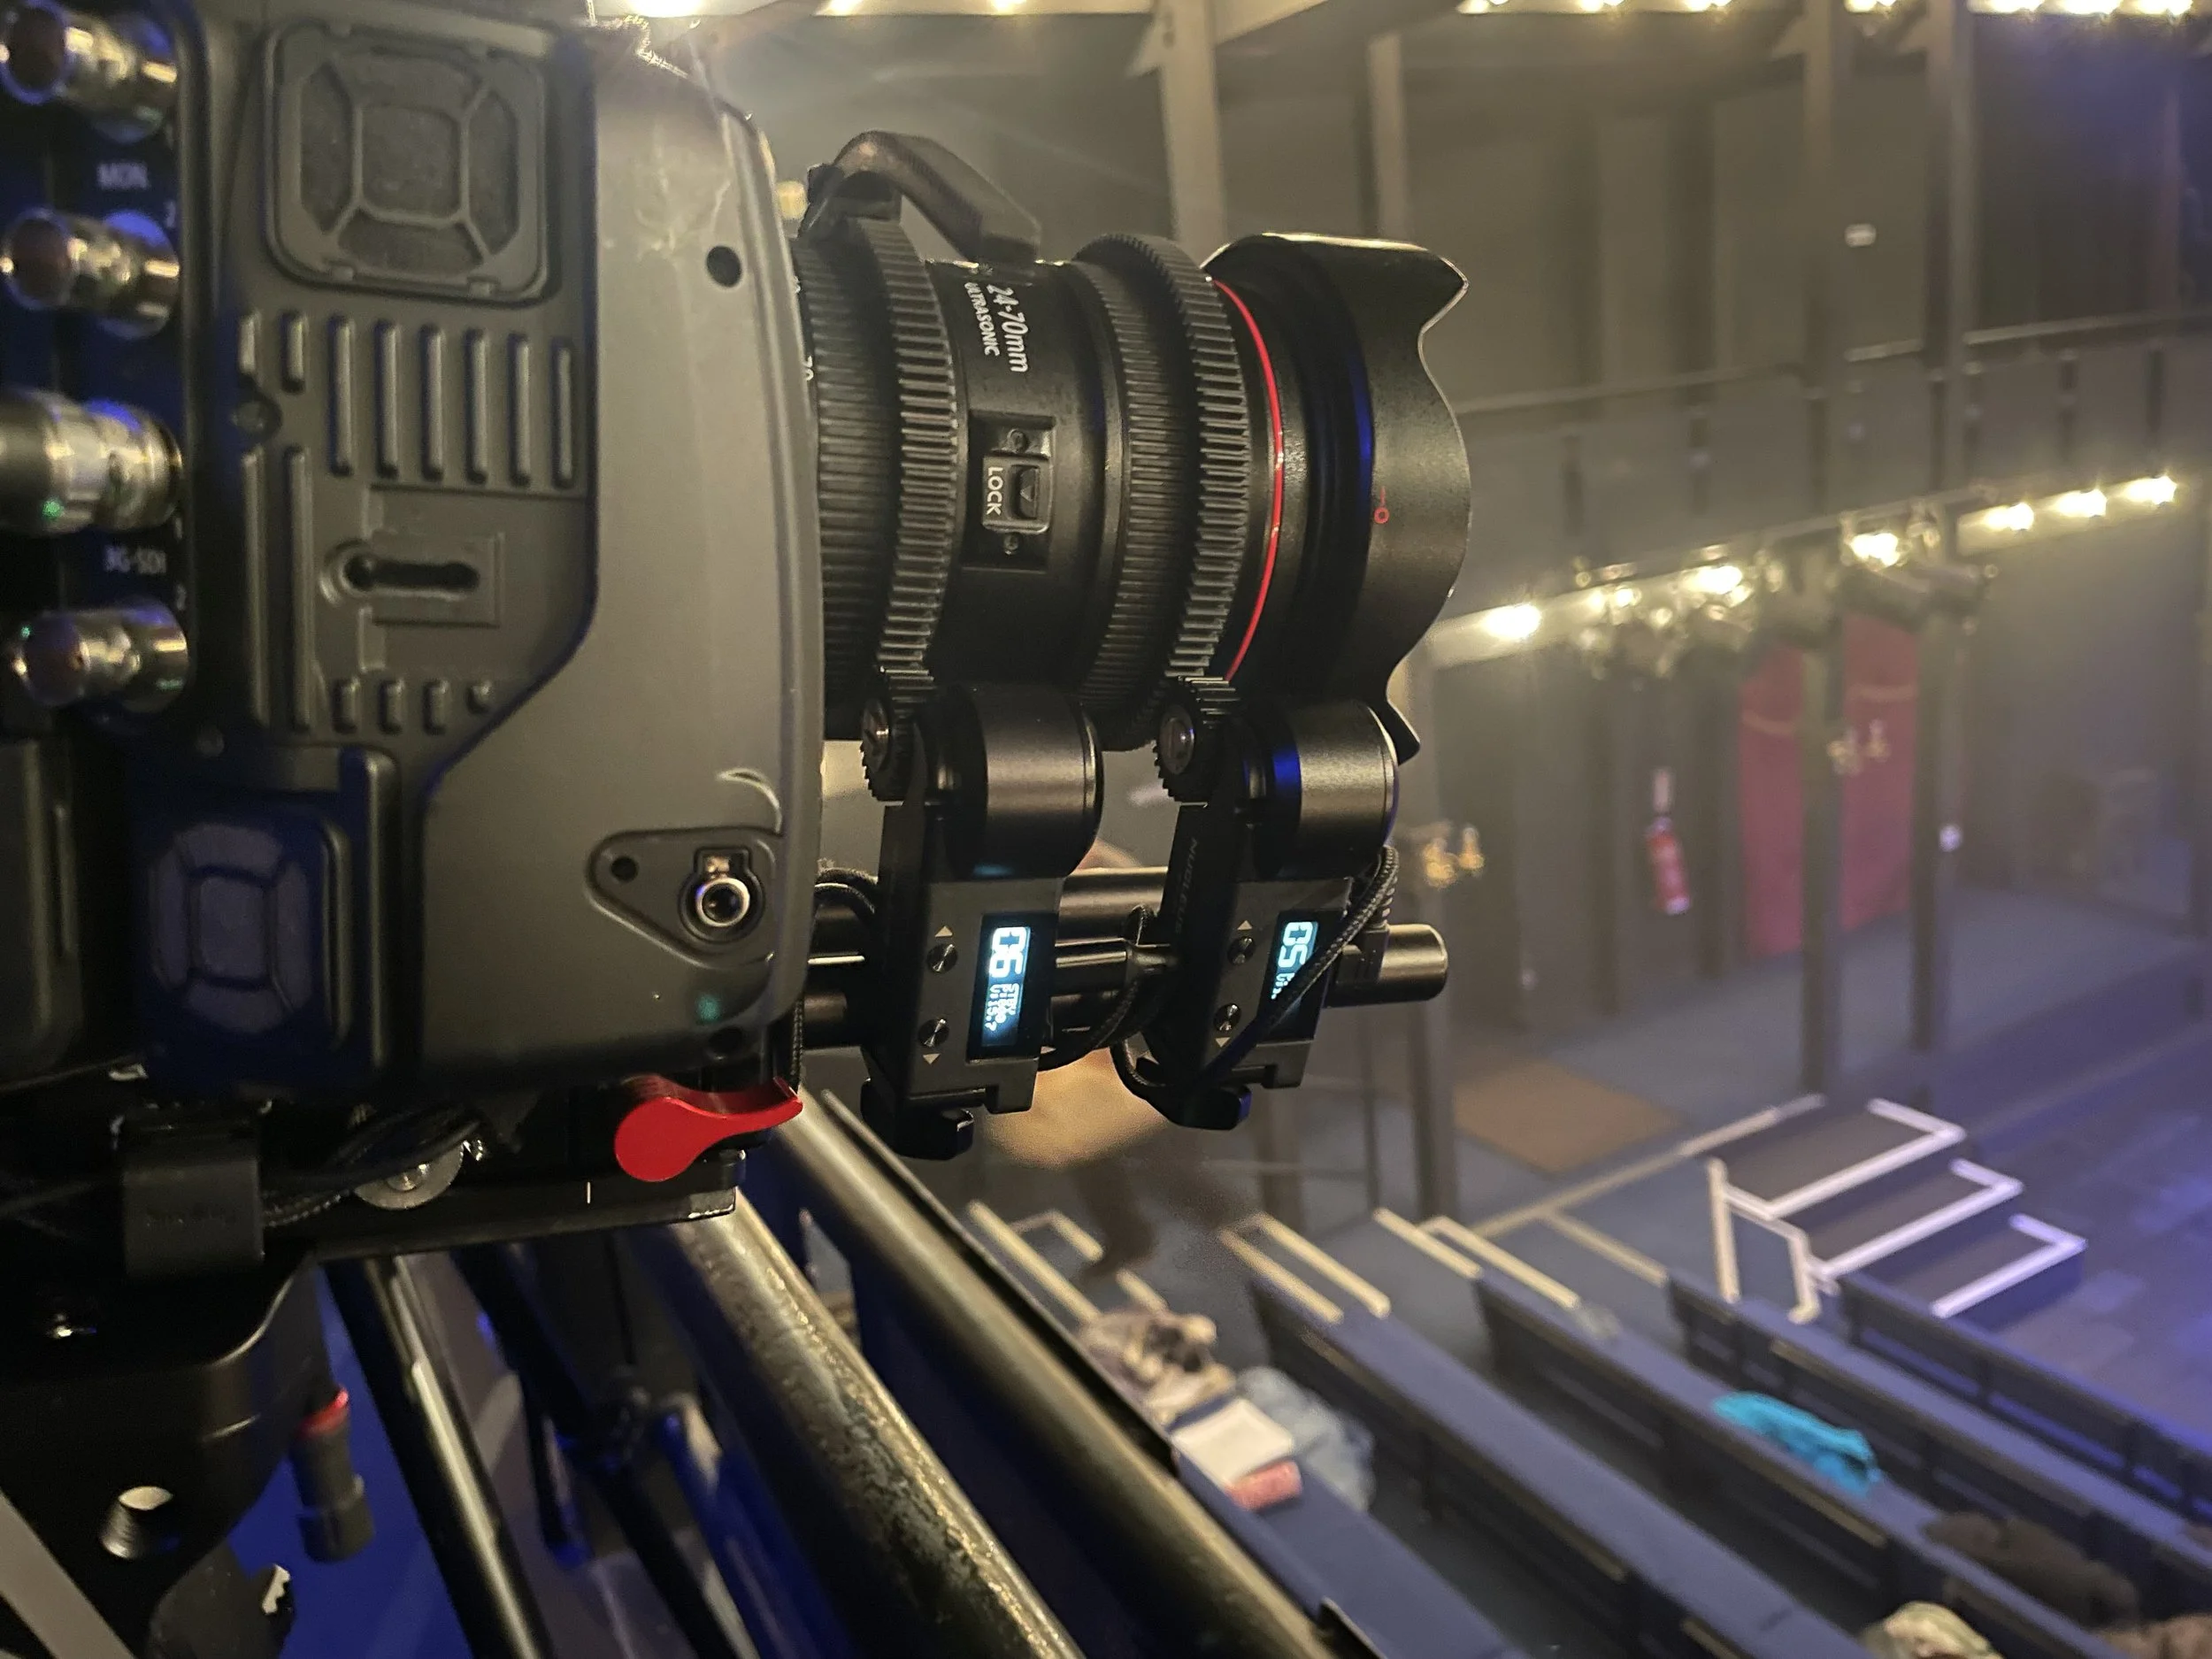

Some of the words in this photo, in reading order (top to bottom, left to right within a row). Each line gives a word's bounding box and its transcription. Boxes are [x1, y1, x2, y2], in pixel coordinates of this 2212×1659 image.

[964, 282, 1000, 356] ULTRASONIC
[987, 284, 1028, 372] 24-70mm
[987, 466, 1003, 516] LOCK
[988, 926, 1026, 979] 06
[1278, 921, 1313, 968] 05
